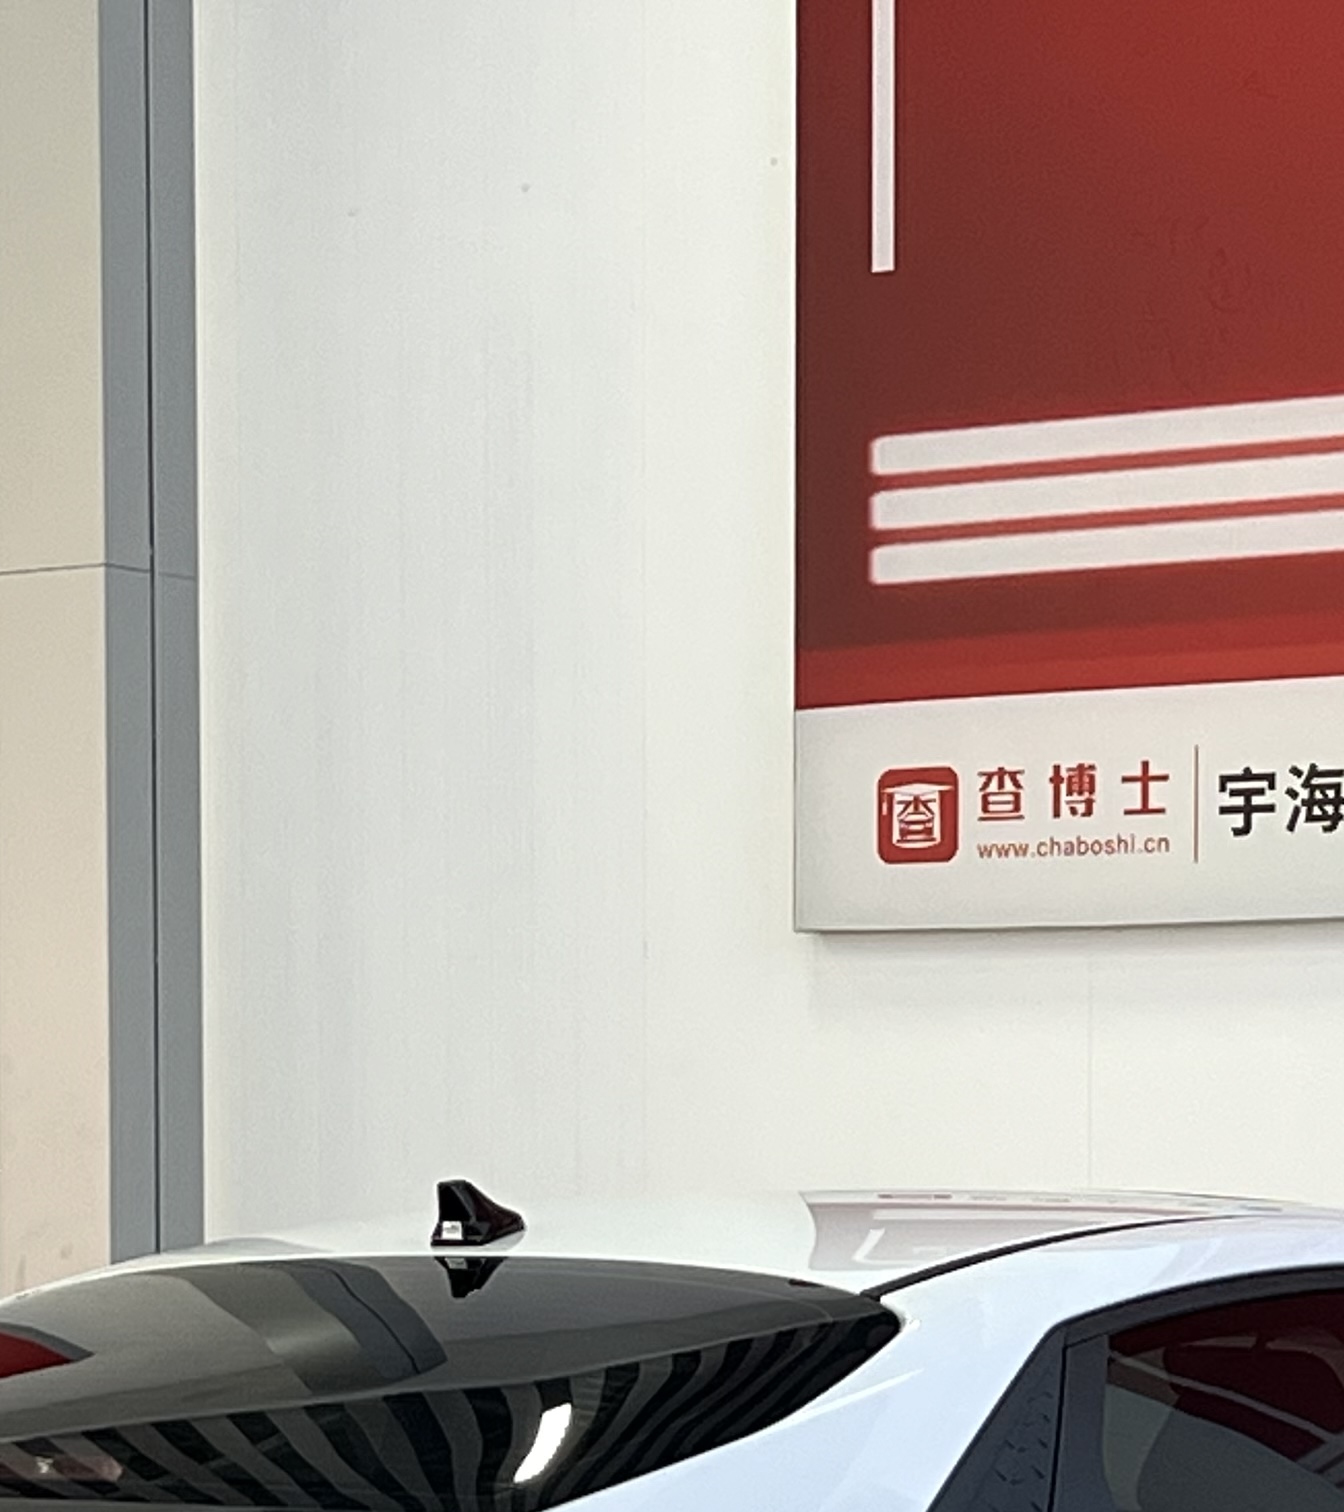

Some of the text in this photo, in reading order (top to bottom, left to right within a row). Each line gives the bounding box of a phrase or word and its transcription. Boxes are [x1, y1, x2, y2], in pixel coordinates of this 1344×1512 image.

[976, 759, 1170, 823] 查博士
[976, 832, 1170, 859] www.chaboshi.cn
